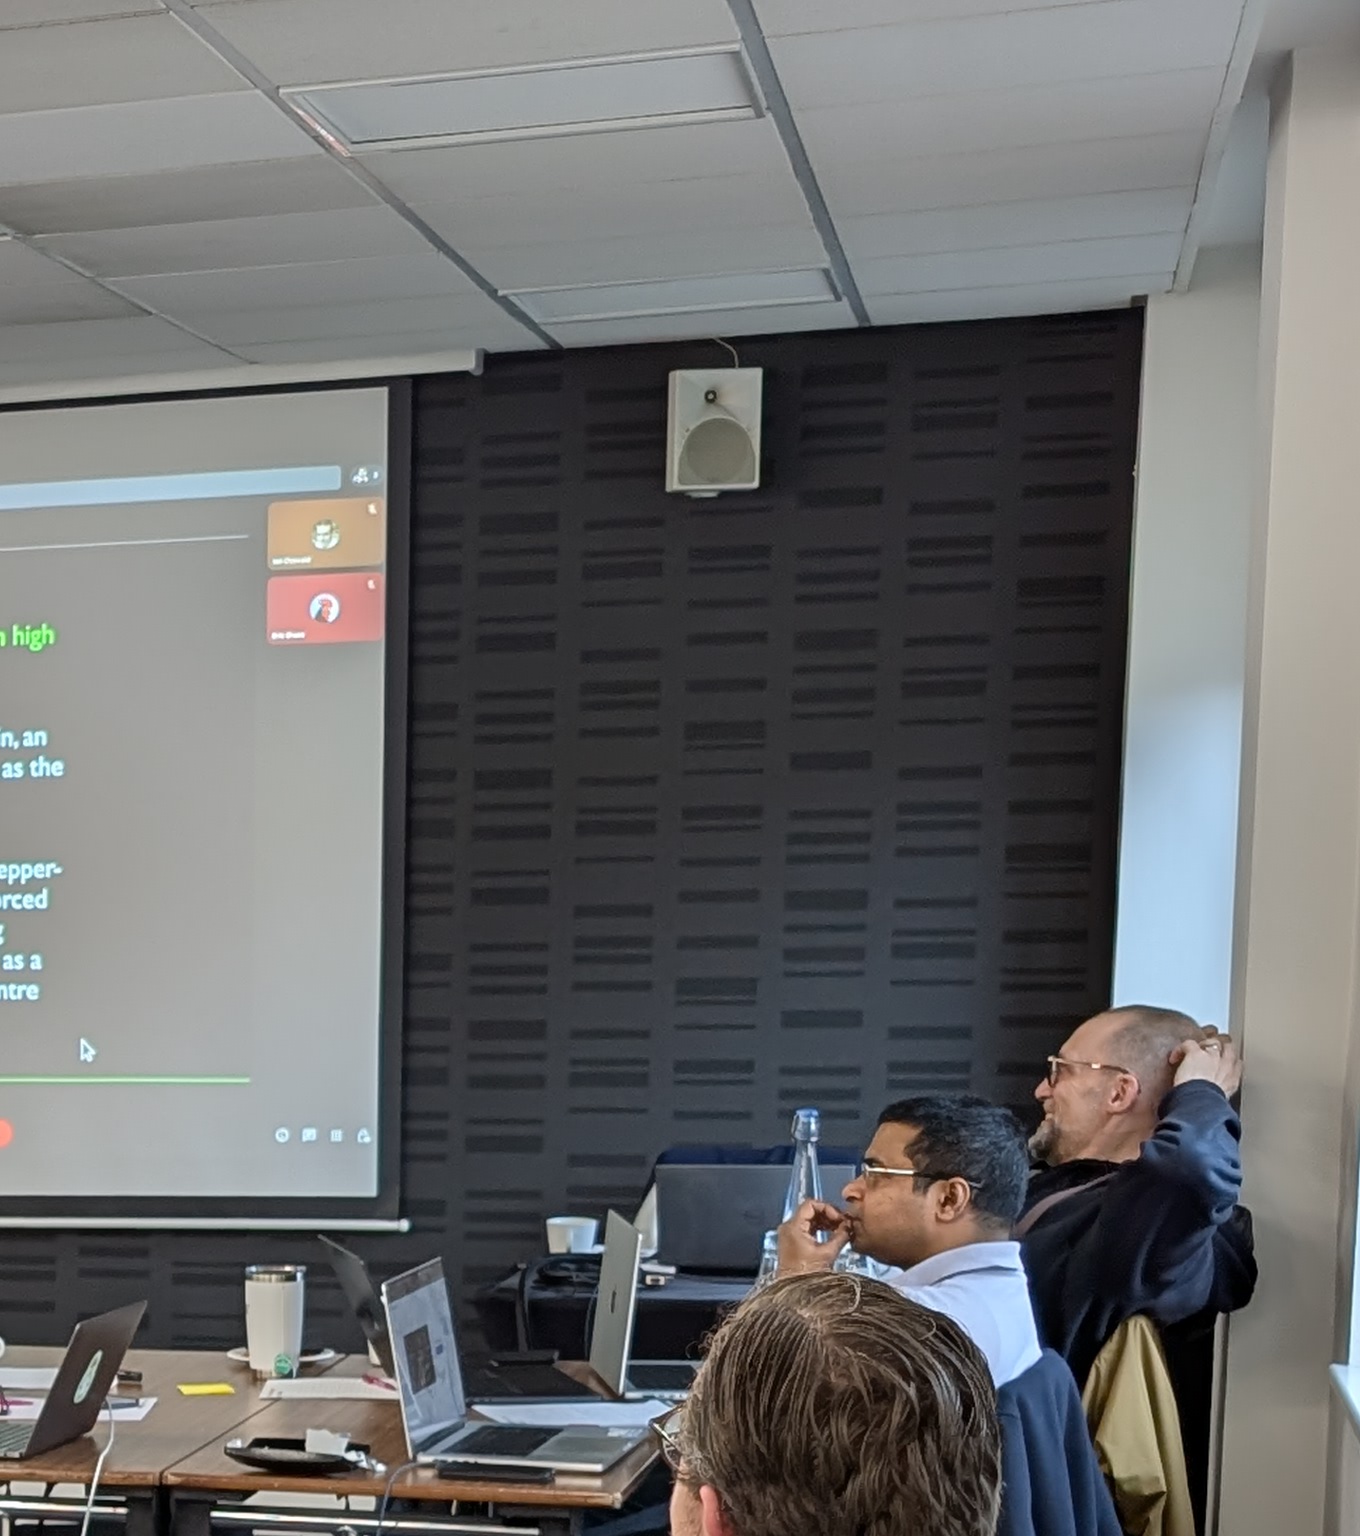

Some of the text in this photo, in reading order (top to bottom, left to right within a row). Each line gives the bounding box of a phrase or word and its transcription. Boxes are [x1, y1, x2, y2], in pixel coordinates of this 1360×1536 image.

[13, 623, 55, 651] high
[23, 731, 47, 746] an
[2, 762, 24, 778] as
[30, 756, 64, 777] the
[3, 955, 24, 970] as
[30, 955, 42, 970] a
